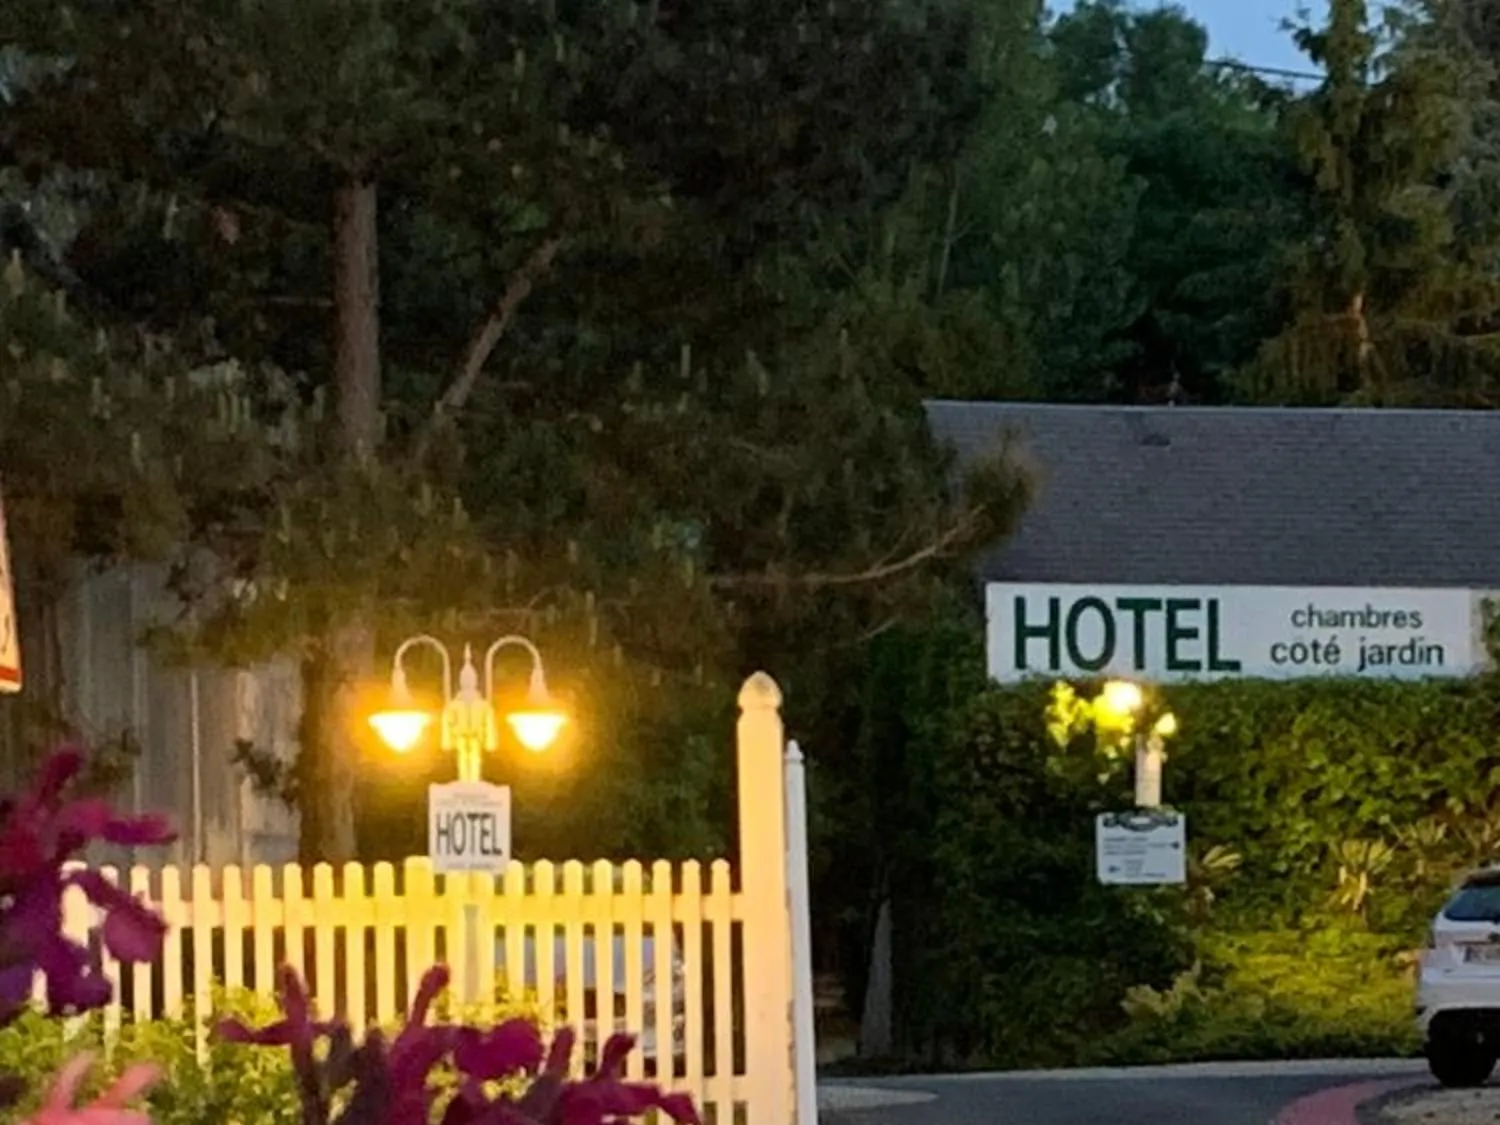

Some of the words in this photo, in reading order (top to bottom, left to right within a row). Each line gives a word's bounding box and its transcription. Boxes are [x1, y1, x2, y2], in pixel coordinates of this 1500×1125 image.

[1013, 596, 1240, 671] HOTEL
[1291, 604, 1422, 628] chambres
[1270, 635, 1342, 666] coté
[1358, 635, 1444, 672] jardin
[436, 811, 503, 856] HOTEL
